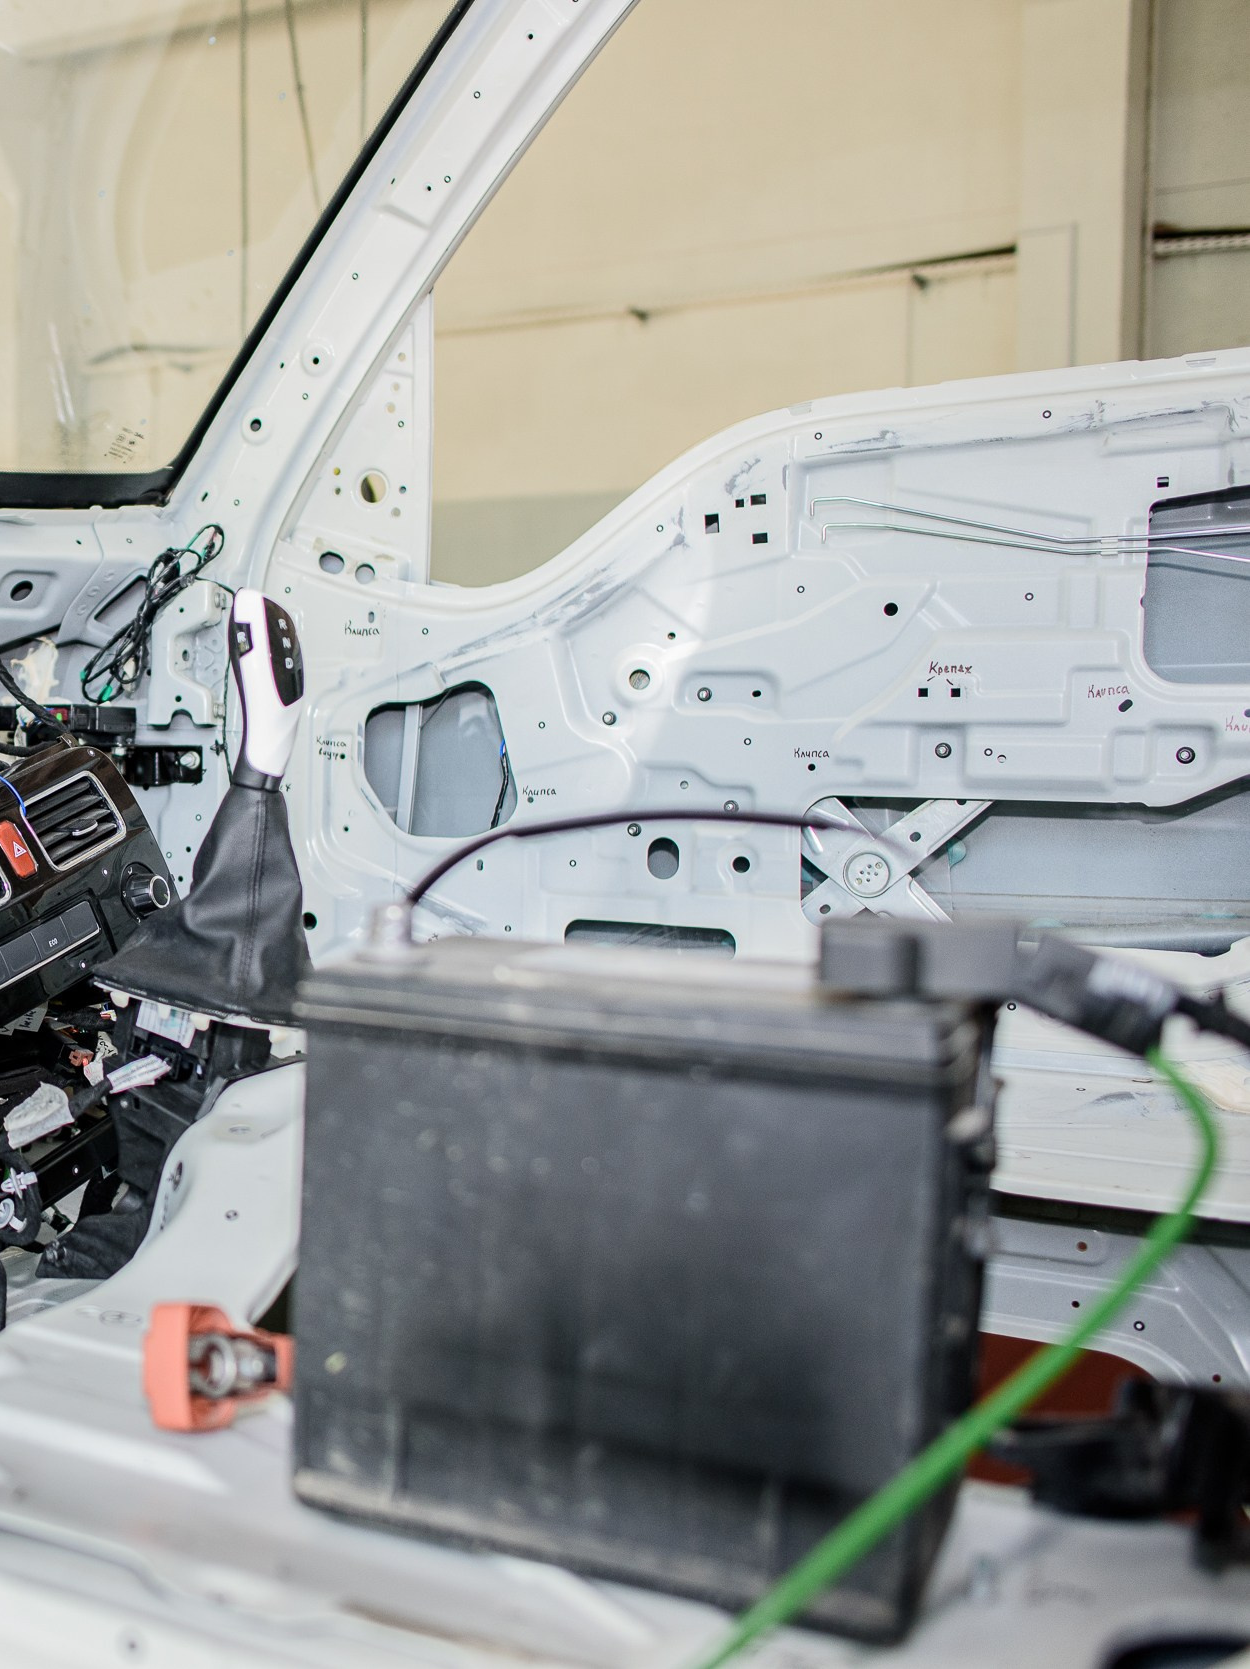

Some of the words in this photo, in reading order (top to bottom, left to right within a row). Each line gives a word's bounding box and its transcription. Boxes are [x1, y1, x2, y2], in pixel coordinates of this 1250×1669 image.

[278, 618, 287, 630] R
[282, 636, 292, 649] N
[1087, 684, 1131, 699] Клипса
[794, 747, 830, 759] Клипса
[522, 785, 557, 797] Клипса
[48, 937, 58, 948] ECO
